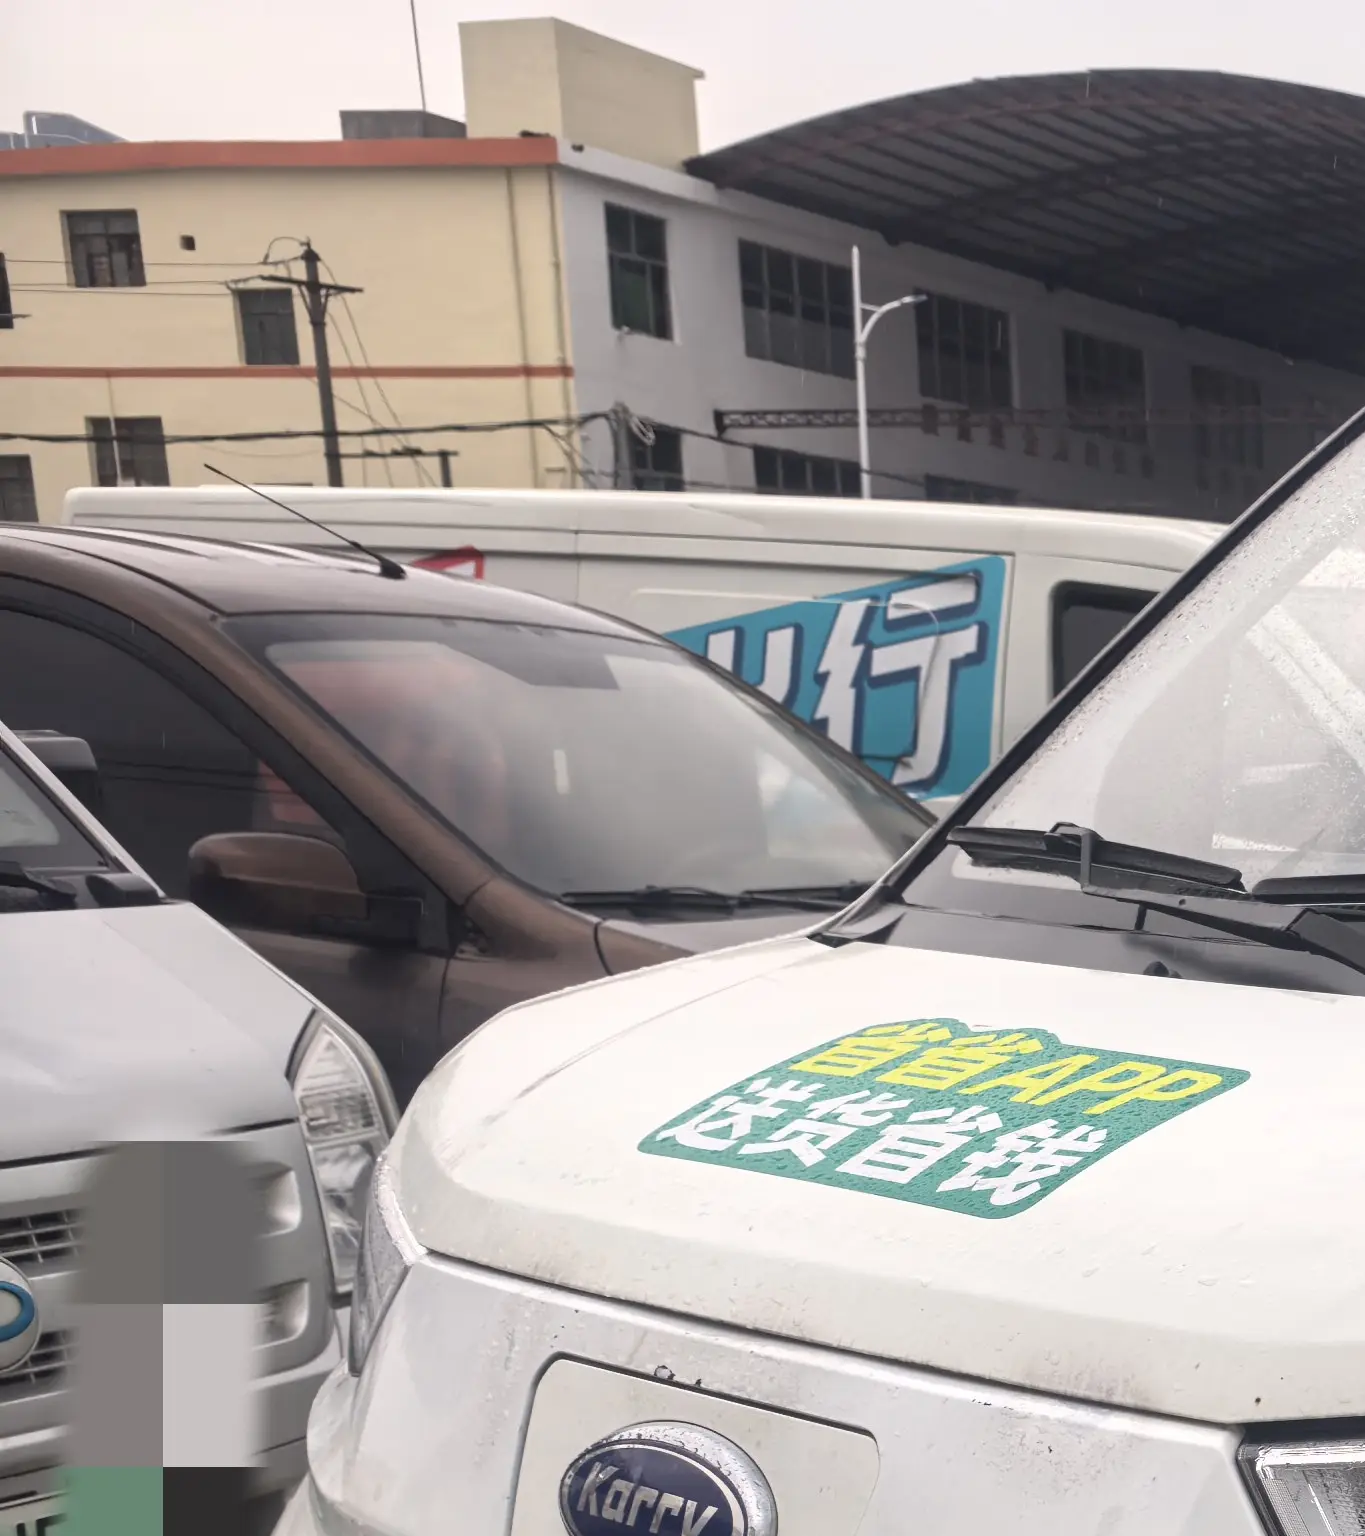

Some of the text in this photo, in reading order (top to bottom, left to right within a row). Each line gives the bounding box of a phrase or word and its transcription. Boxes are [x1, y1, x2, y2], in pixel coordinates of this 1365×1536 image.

[788, 1022, 1223, 1115] 省省APP
[656, 1076, 1108, 1206] 送货省钱
